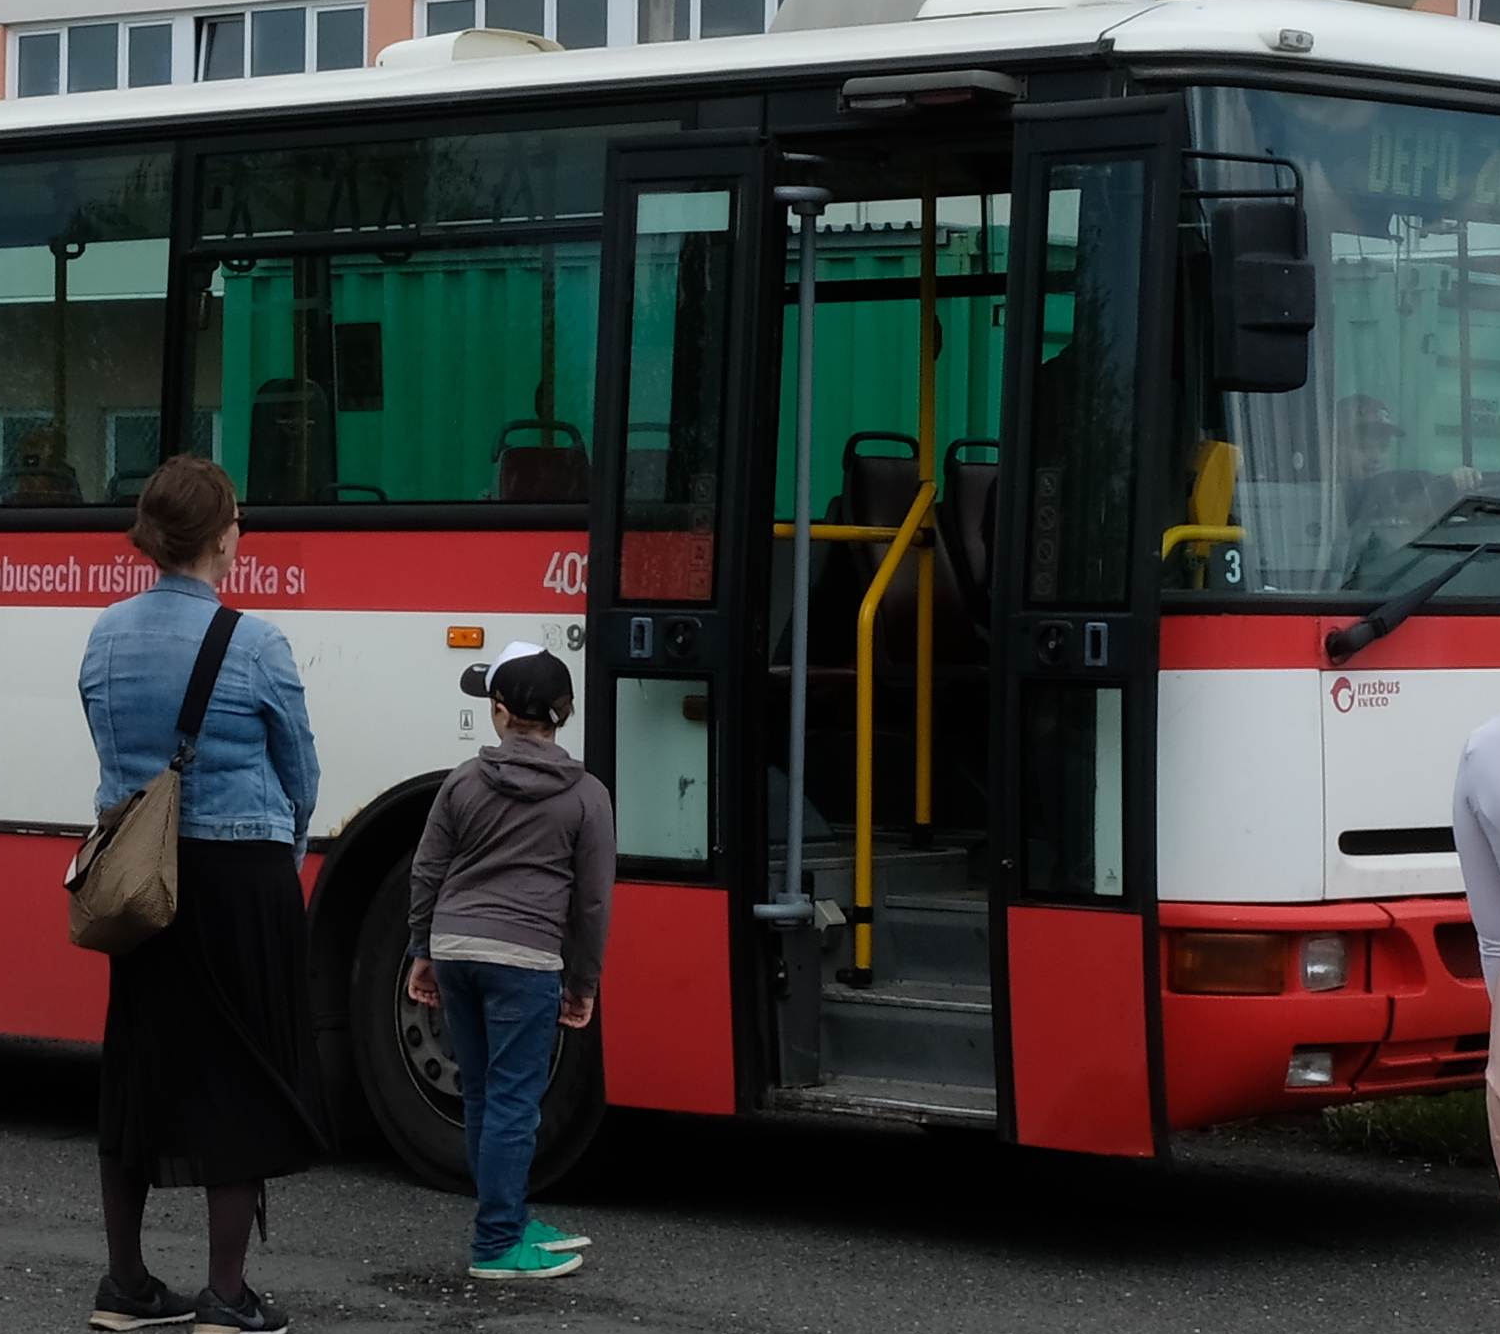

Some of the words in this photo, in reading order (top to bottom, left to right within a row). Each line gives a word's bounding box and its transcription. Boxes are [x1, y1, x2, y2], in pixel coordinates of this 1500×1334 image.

[1368, 127, 1459, 201] DEPO
[1224, 549, 1241, 584] 3
[1357, 696, 1389, 708] IVECO
